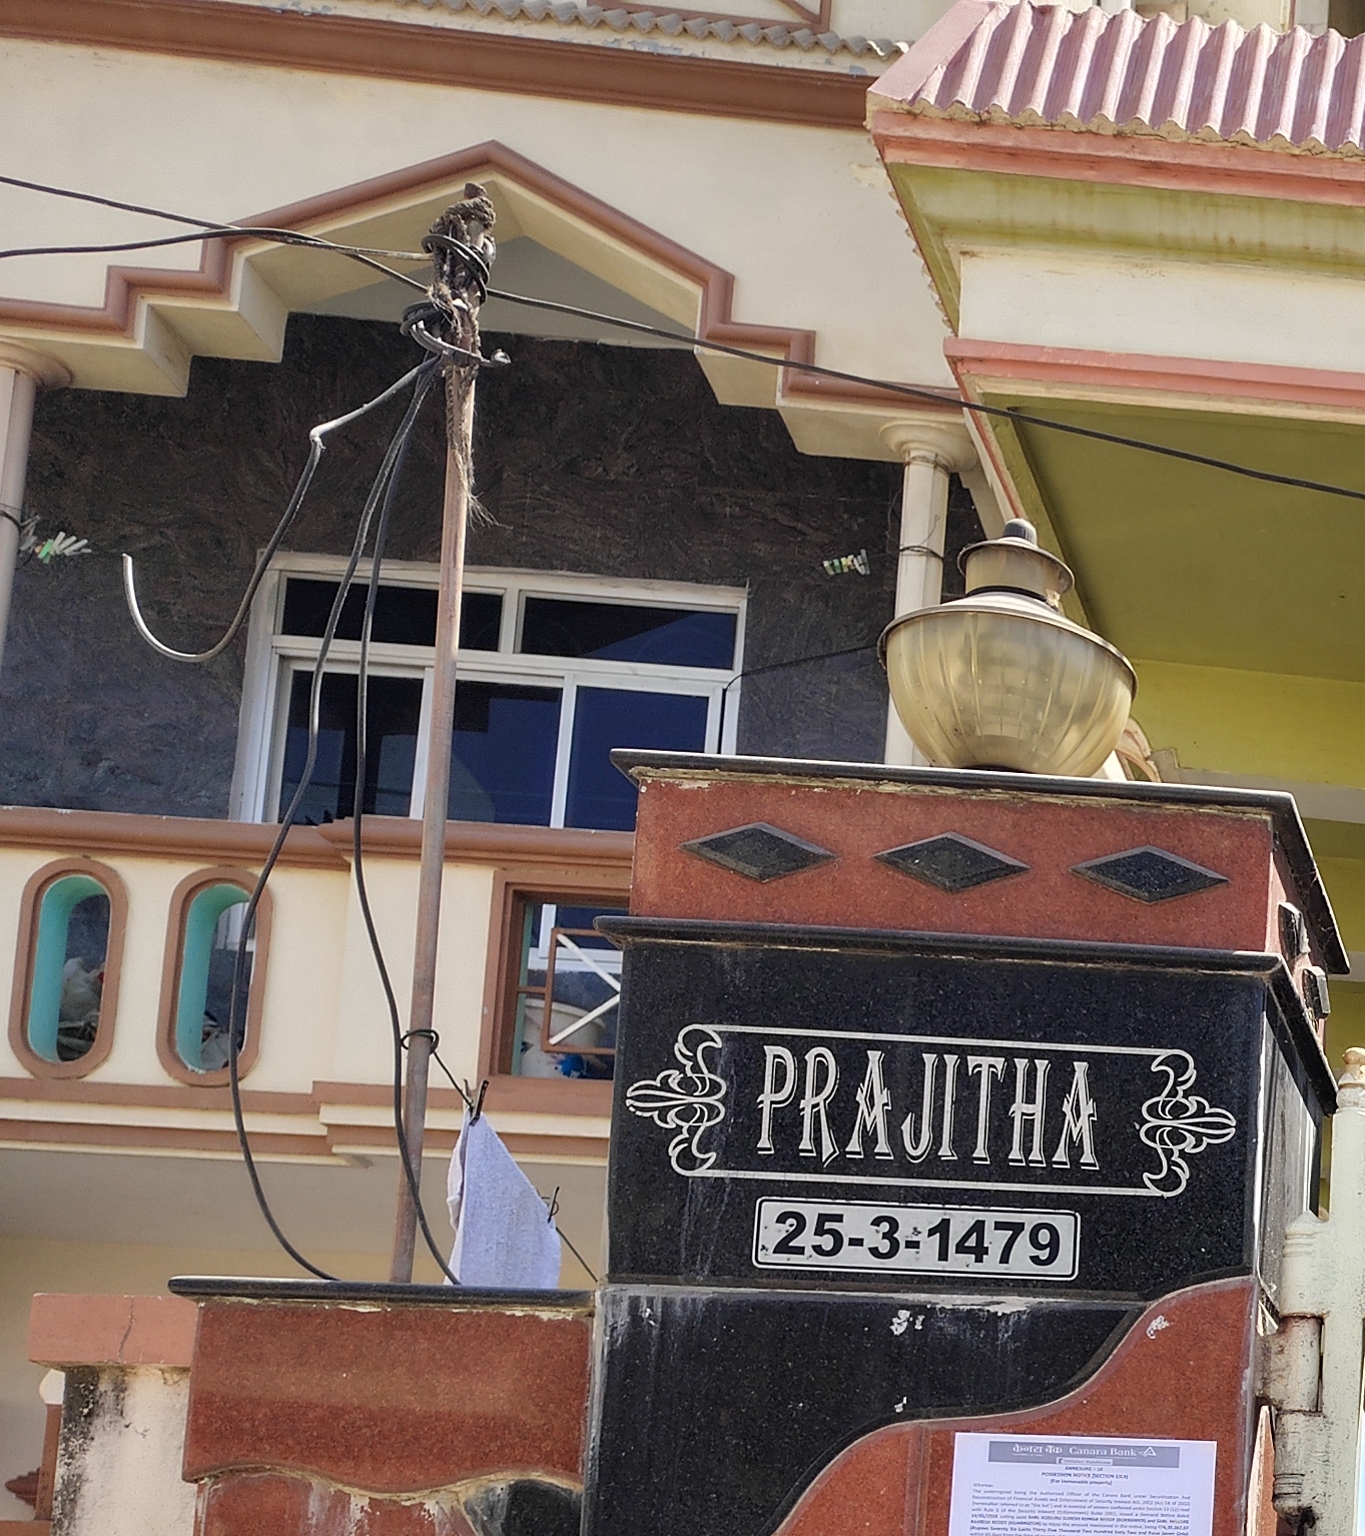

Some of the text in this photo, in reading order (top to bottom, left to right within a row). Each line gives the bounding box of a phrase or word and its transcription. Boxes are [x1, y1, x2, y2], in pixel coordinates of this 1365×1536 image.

[756, 1044, 1101, 1171] PRAJITHA
[772, 1210, 1062, 1267] 25-3-1479
[1068, 1445, 1137, 1456] Canara Bank
